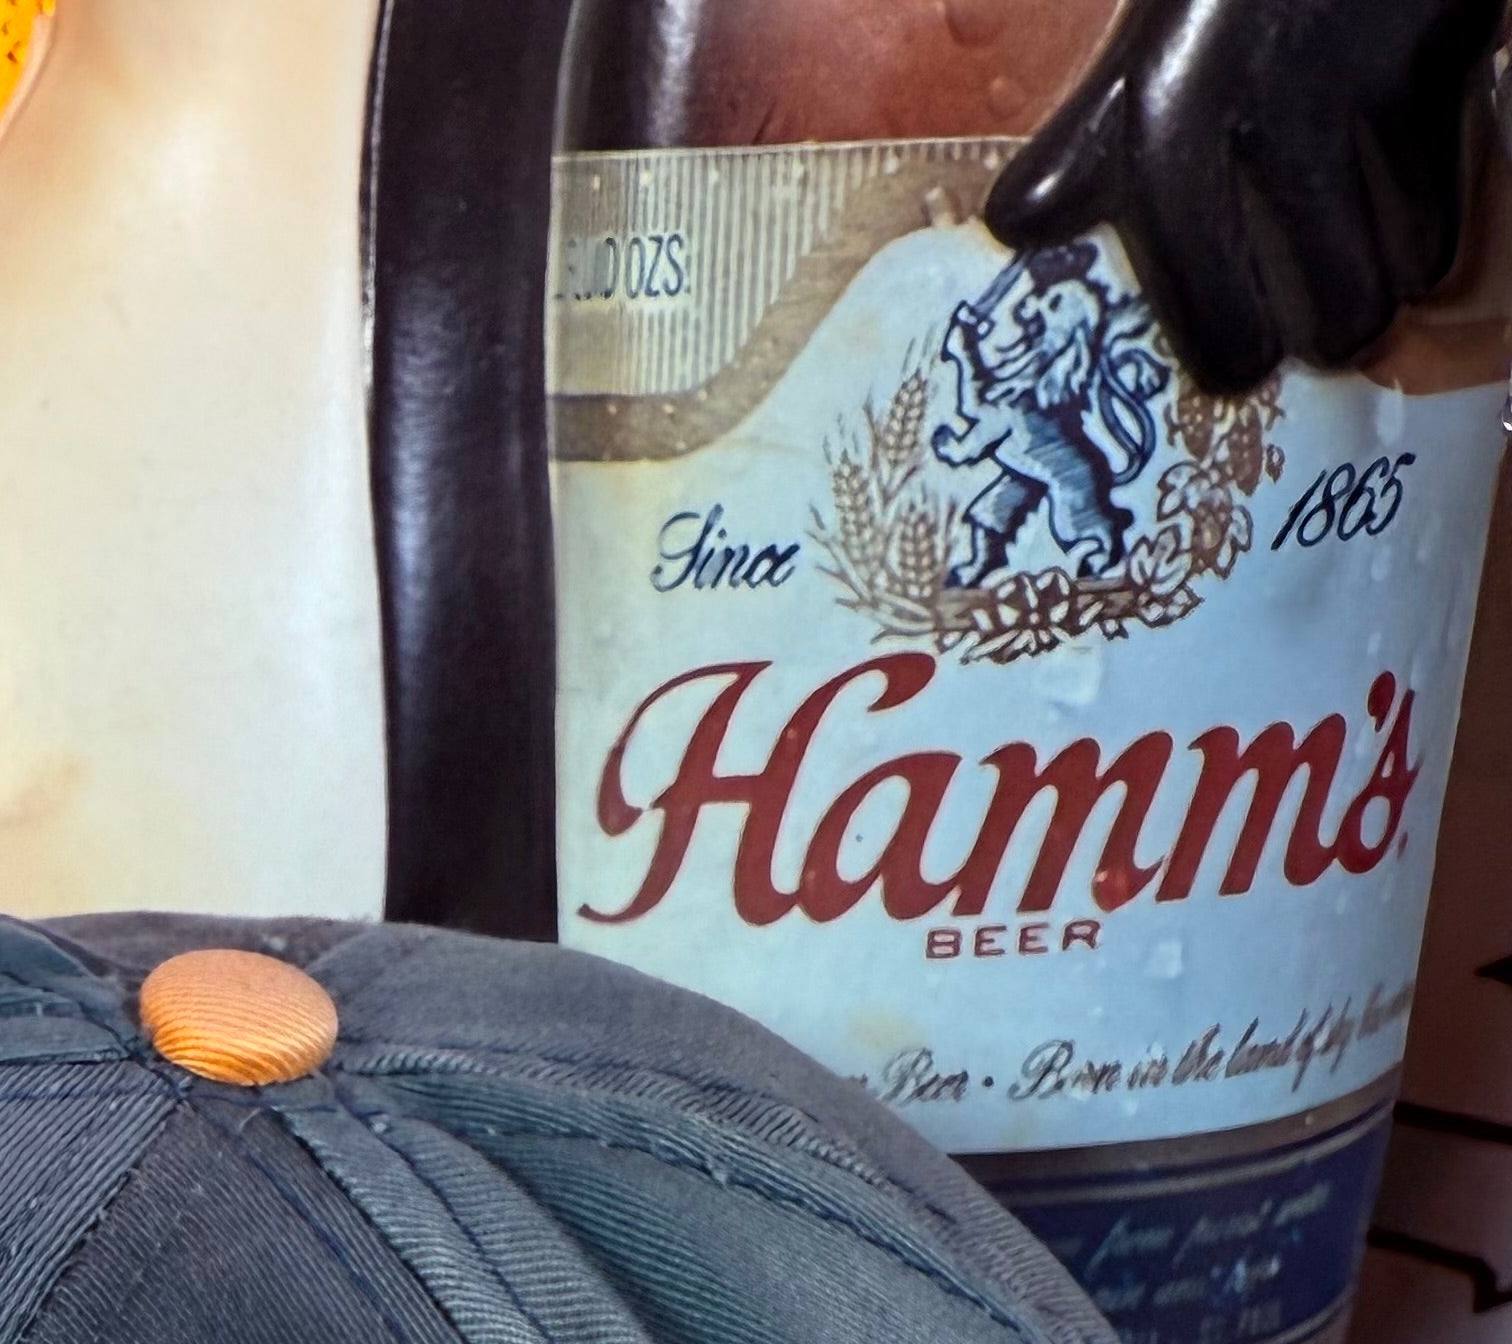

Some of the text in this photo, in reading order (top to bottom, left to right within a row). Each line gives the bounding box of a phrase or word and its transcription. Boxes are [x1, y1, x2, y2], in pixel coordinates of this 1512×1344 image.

[1270, 452, 1416, 551] 1865
[576, 651, 1425, 927] Hamm's
[925, 919, 1102, 961] BEER
